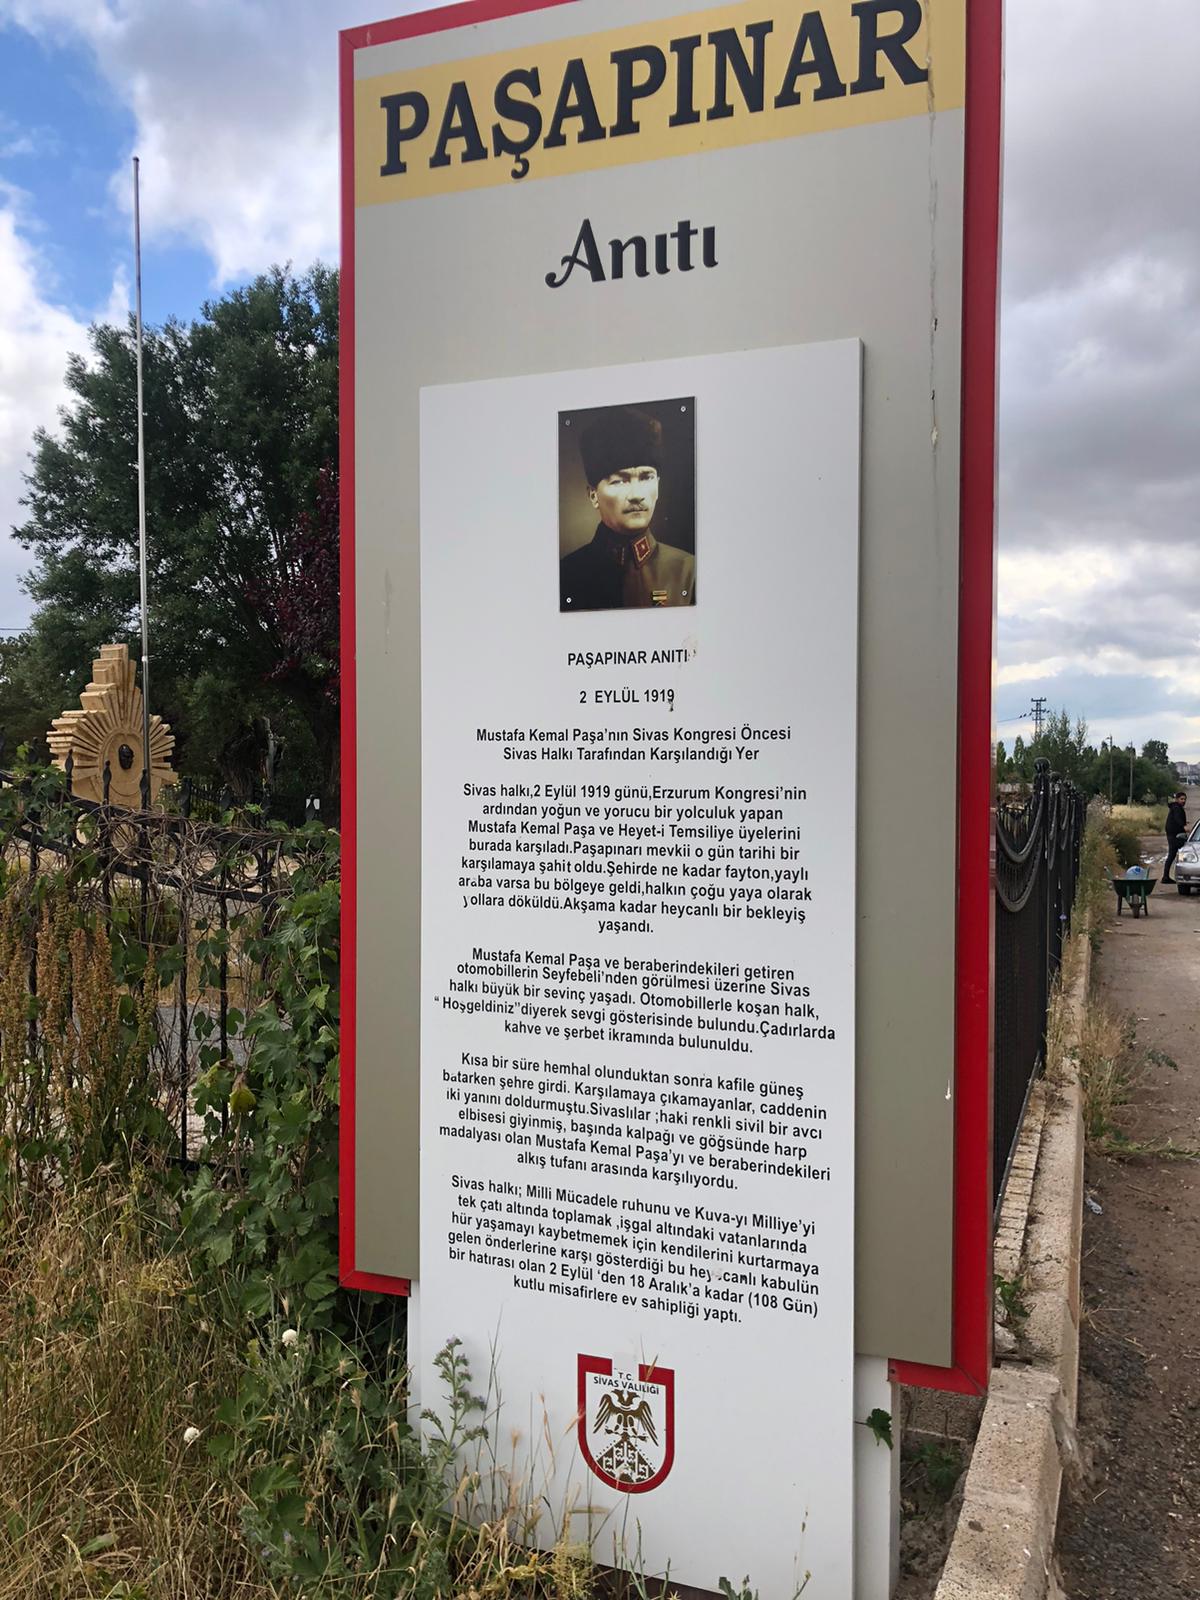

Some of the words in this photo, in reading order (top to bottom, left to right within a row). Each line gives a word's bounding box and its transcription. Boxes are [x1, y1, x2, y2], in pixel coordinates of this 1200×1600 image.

[379, 0, 929, 179] PAŞAPINAR
[545, 218, 718, 288] Anıtı
[568, 650, 647, 669] PAŞAPINAR
[650, 649, 688, 664] ANITI
[579, 690, 587, 704] 2
[595, 686, 640, 703] EYLÜL
[644, 689, 675, 703] 1919
[477, 728, 525, 742] Mustafa
[529, 728, 568, 742] Kemal
[633, 728, 669, 741] Sivas
[674, 727, 736, 744] Kongresi
[741, 723, 791, 740] Öncesi
[503, 747, 537, 760] Sivas
[541, 747, 573, 760] Halkı
[576, 747, 646, 760] Tarafından
[650, 746, 732, 764] Karşılandığı
[735, 746, 760, 760] Yer
[463, 783, 496, 797] Sivas
[545, 784, 576, 801] Eylül
[581, 785, 610, 798] 1919
[482, 802, 537, 815] ardından
[541, 803, 581, 820] yoğun
[585, 807, 600, 817] ve
[604, 807, 650, 820] yorucu
[654, 805, 673, 818] bir
[676, 805, 735, 822] yolculuk
[739, 809, 783, 823] yapan
[468, 820, 516, 834] Mustafa
[521, 821, 560, 835] Kemal
[564, 822, 595, 839] Paşa
[599, 826, 614, 836] ve
[619, 823, 664, 840] Heyet-i
[669, 824, 734, 842] Temsiliye
[739, 825, 800, 843] üyelerini
[461, 856, 535, 874] karşılamaya
[539, 859, 571, 875] şahit
[662, 866, 678, 876] ne
[682, 863, 721, 878] kadar
[469, 838, 512, 852] burada
[646, 844, 690, 857] mevkii
[695, 847, 703, 858] o
[708, 845, 734, 862] gün
[739, 846, 775, 860] tarihi
[780, 846, 800, 860] bir
[496, 879, 530, 889] varsa
[534, 877, 550, 890] bu
[554, 878, 605, 895] bölgeye
[690, 883, 725, 901] çoğu
[729, 888, 762, 902] yaya
[767, 886, 812, 901] olarak
[620, 899, 657, 914] kadar
[661, 901, 718, 919] heycanlı
[723, 904, 742, 918] bir
[746, 905, 806, 925] bekleyiş
[457, 962, 538, 979] otomobillerin
[642, 973, 709, 990] görülmesi
[714, 978, 766, 994] üzerine
[770, 981, 810, 997] Sivas
[472, 947, 521, 963] Mustafa
[525, 950, 565, 968] Kemal
[569, 953, 601, 970] Paşa
[604, 958, 620, 969] ve
[624, 956, 739, 977] beraberindekileri
[744, 965, 794, 982] getiren
[449, 979, 478, 993] halkı
[482, 981, 520, 998] büyük
[523, 984, 541, 997] bir
[544, 987, 585, 1004] sevinç
[640, 992, 732, 1012] Otomobillerle
[737, 999, 780, 1017] koşan
[505, 1019, 541, 1035] kahve
[545, 1026, 560, 1037] ve
[564, 1026, 605, 1041] şerbet
[609, 1028, 674, 1046] ikramında
[571, 1008, 605, 1024] sevgi
[609, 1010, 693, 1028] gösterisinde
[462, 1052, 488, 1067] Kısa
[492, 1055, 509, 1069] bir
[512, 1058, 540, 1072] süre
[544, 1059, 590, 1076] hemhal
[594, 1065, 669, 1084] olunduktan
[674, 1075, 713, 1088] sonra
[717, 1076, 755, 1093] kafile
[759, 1081, 804, 1101] güneş
[499, 1075, 534, 1090] şehre
[538, 1079, 570, 1094] girdi.
[575, 1081, 655, 1105] Karşılamaya
[660, 1091, 755, 1115] çıkamayanlar,
[760, 1102, 827, 1120] caddenin
[458, 1107, 505, 1124] elbisesi
[509, 1113, 566, 1134] giyinmiş,
[571, 1119, 622, 1137] başında
[626, 1125, 674, 1146] kalpağı
[679, 1134, 695, 1145] ve
[699, 1134, 770, 1154] göğsünde
[774, 1141, 807, 1161] harp
[464, 1092, 501, 1105] yanını
[692, 1115, 731, 1130] renkli
[735, 1118, 764, 1133] sivil
[769, 1120, 788, 1136] bir
[793, 1126, 822, 1140] avcı
[439, 1125, 501, 1143] madalyası
[505, 1131, 531, 1146] olan
[536, 1134, 586, 1152] Mustafa
[590, 1140, 631, 1157] Kemal
[688, 1154, 704, 1166] ve
[709, 1153, 830, 1181] beraberindekileri
[517, 1151, 546, 1169] alkış
[550, 1155, 587, 1171] tufanı
[591, 1162, 648, 1178] arasında
[652, 1166, 738, 1190] karşılıyordu.
[451, 1175, 485, 1191] Sivas
[489, 1179, 522, 1198] halkı;
[526, 1184, 552, 1200] Milli
[556, 1188, 618, 1209] Mücadele
[622, 1198, 670, 1216] ruhunu
[674, 1207, 690, 1218] ve
[695, 1206, 747, 1228] Kuva-yı
[458, 1194, 476, 1208] tek
[480, 1199, 502, 1213] çatı
[506, 1201, 548, 1218] altında
[552, 1207, 612, 1227] toplamak
[656, 1221, 714, 1241] altındaki
[718, 1232, 807, 1254] vatanlarında
[452, 1211, 472, 1225] hür
[475, 1217, 534, 1237] yaşamayı
[538, 1223, 628, 1248] kaybetmemek
[633, 1236, 656, 1253] için
[661, 1240, 733, 1263] kendilerini
[738, 1251, 819, 1277] kurtarmaya
[448, 1230, 482, 1245] gelen
[485, 1234, 557, 1256] önderlerine
[596, 1251, 663, 1275] gösterdiği
[668, 1260, 685, 1275] bu
[761, 1274, 819, 1295] kabulün
[449, 1246, 466, 1260] bir
[469, 1249, 514, 1269] hatırası
[519, 1258, 545, 1273] olan
[549, 1262, 557, 1275] 2
[561, 1263, 593, 1281] Eylül
[630, 1274, 645, 1288] 18
[705, 1285, 744, 1303] kadar
[514, 1275, 545, 1292] kutlu
[549, 1282, 618, 1303] misafirlere
[622, 1295, 637, 1306] ev
[641, 1297, 699, 1319] sahipliği
[703, 1307, 742, 1323] yaptı.
